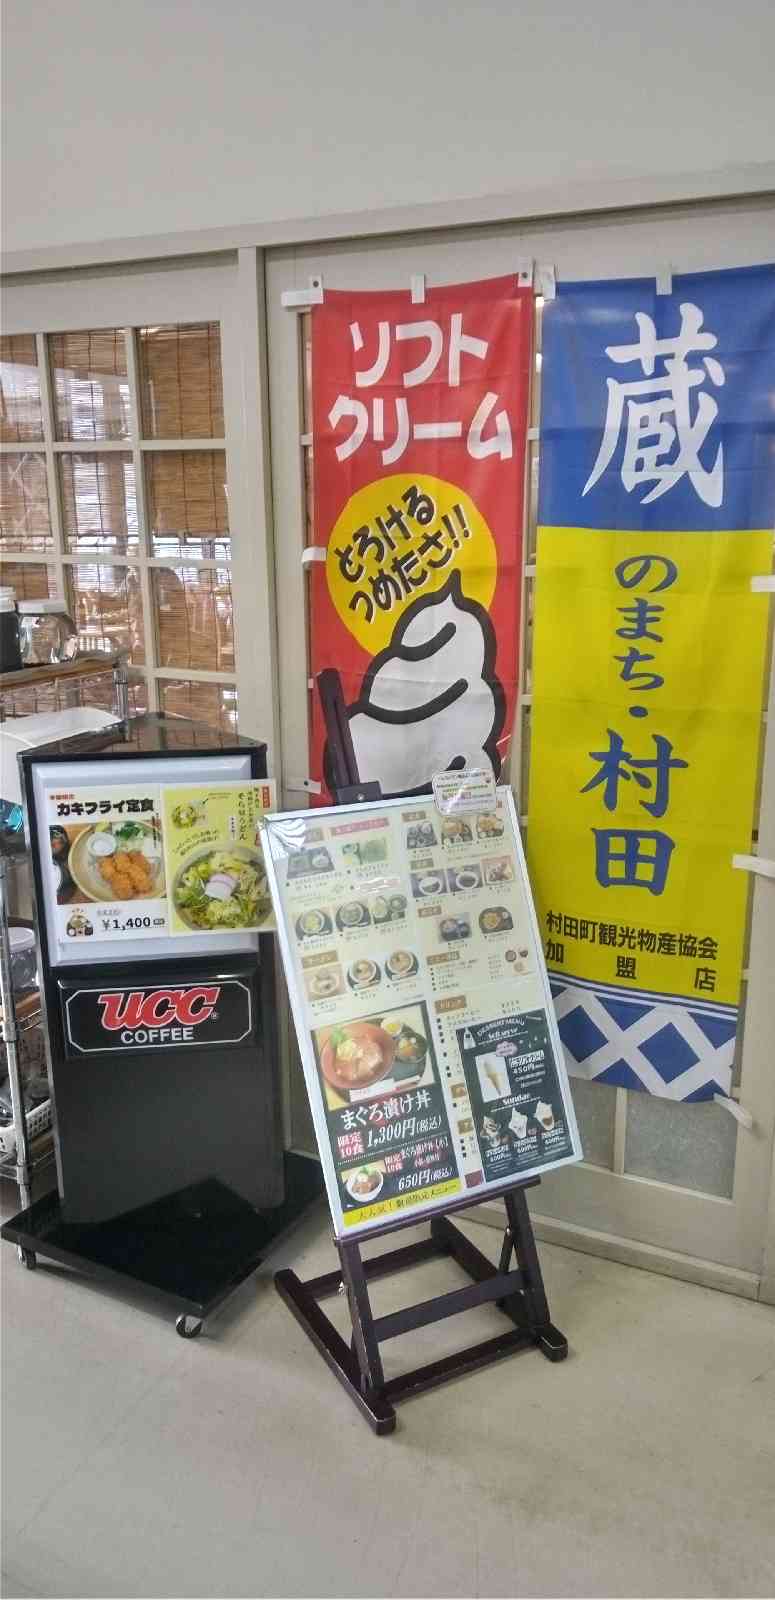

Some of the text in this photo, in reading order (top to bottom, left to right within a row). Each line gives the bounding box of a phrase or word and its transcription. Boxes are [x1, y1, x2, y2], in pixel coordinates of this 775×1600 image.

[350, 313, 488, 388] ソフト
[327, 391, 513, 466] クリーム
[333, 485, 436, 583] とろける
[57, 798, 154, 817] カキフライ定食
[102, 916, 151, 931] ¥1,400
[546, 910, 719, 961] 村田町観光物産協会
[121, 1027, 194, 1044] COFFEE
